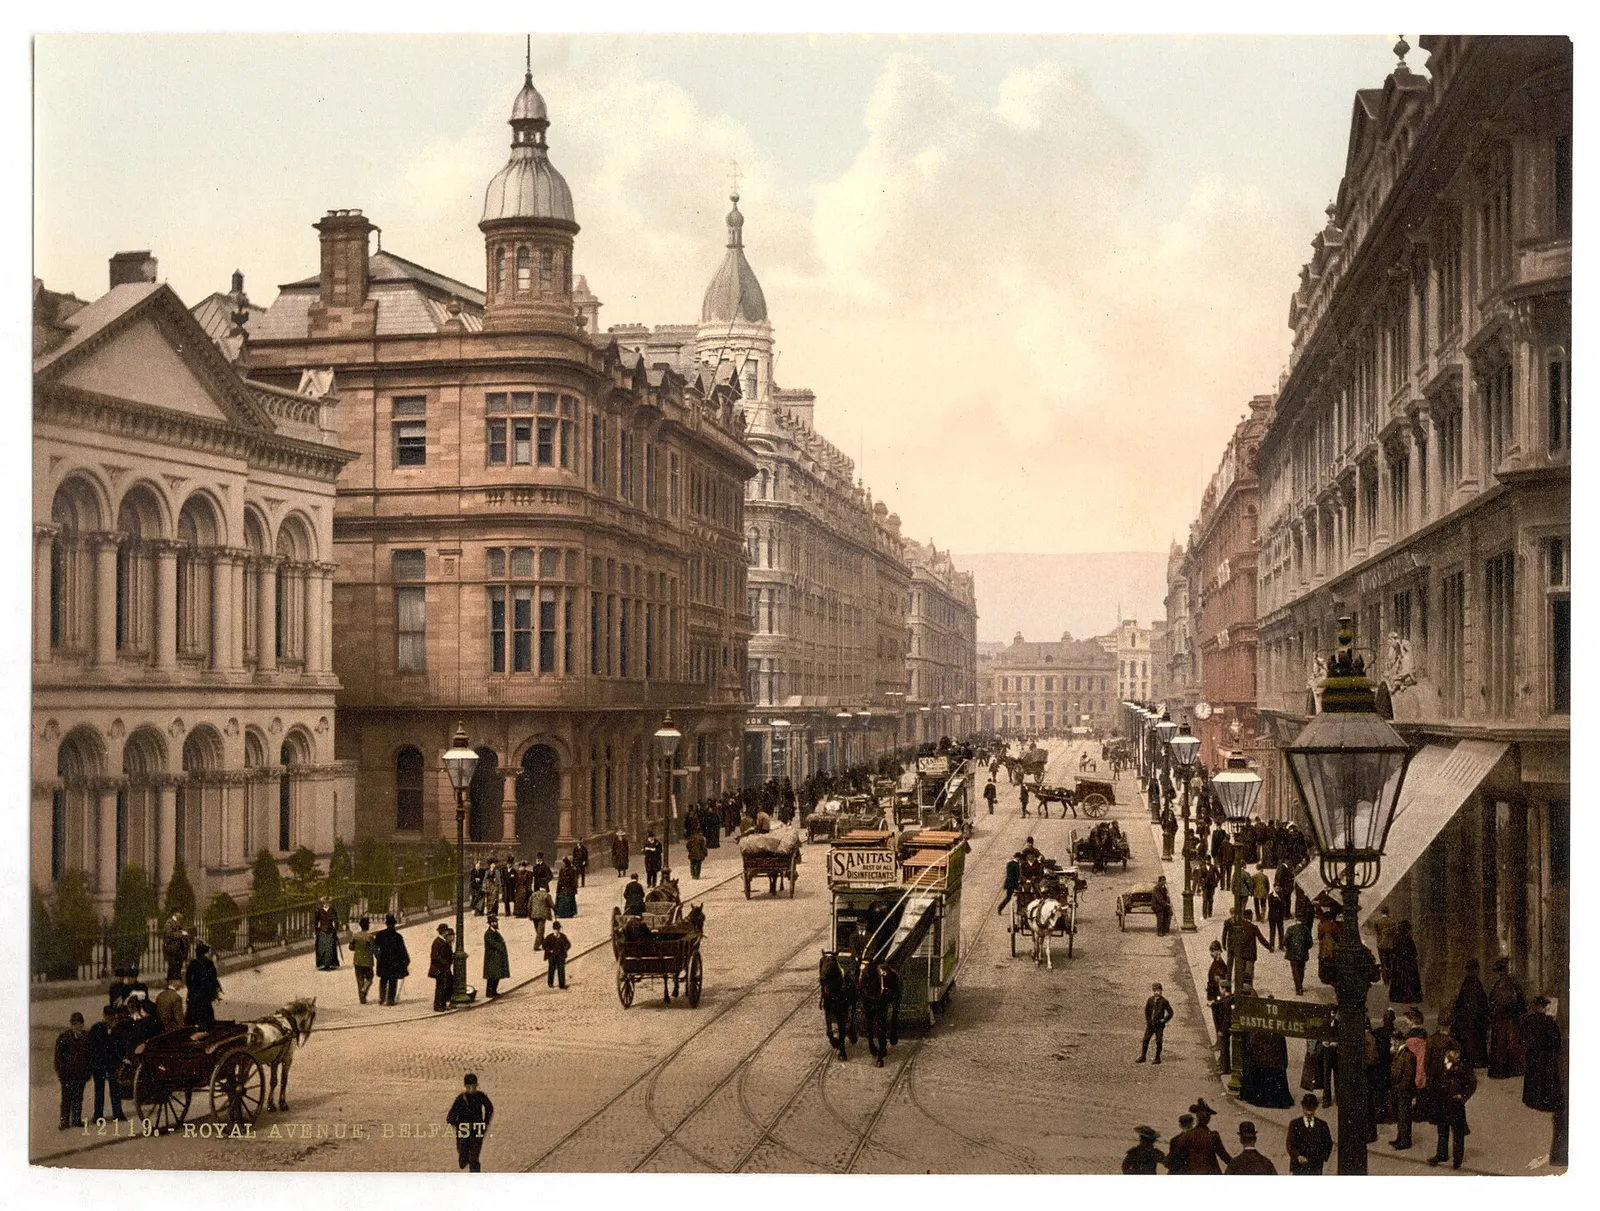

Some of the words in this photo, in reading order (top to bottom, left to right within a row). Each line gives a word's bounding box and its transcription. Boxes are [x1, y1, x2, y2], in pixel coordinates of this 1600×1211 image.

[834, 852, 893, 876] SANITAS
[847, 871, 893, 879] DISINFECTANTS
[1266, 1004, 1278, 1015] TO
[1240, 1015, 1274, 1029] CASTLE
[1276, 1020, 1305, 1032] PLACE
